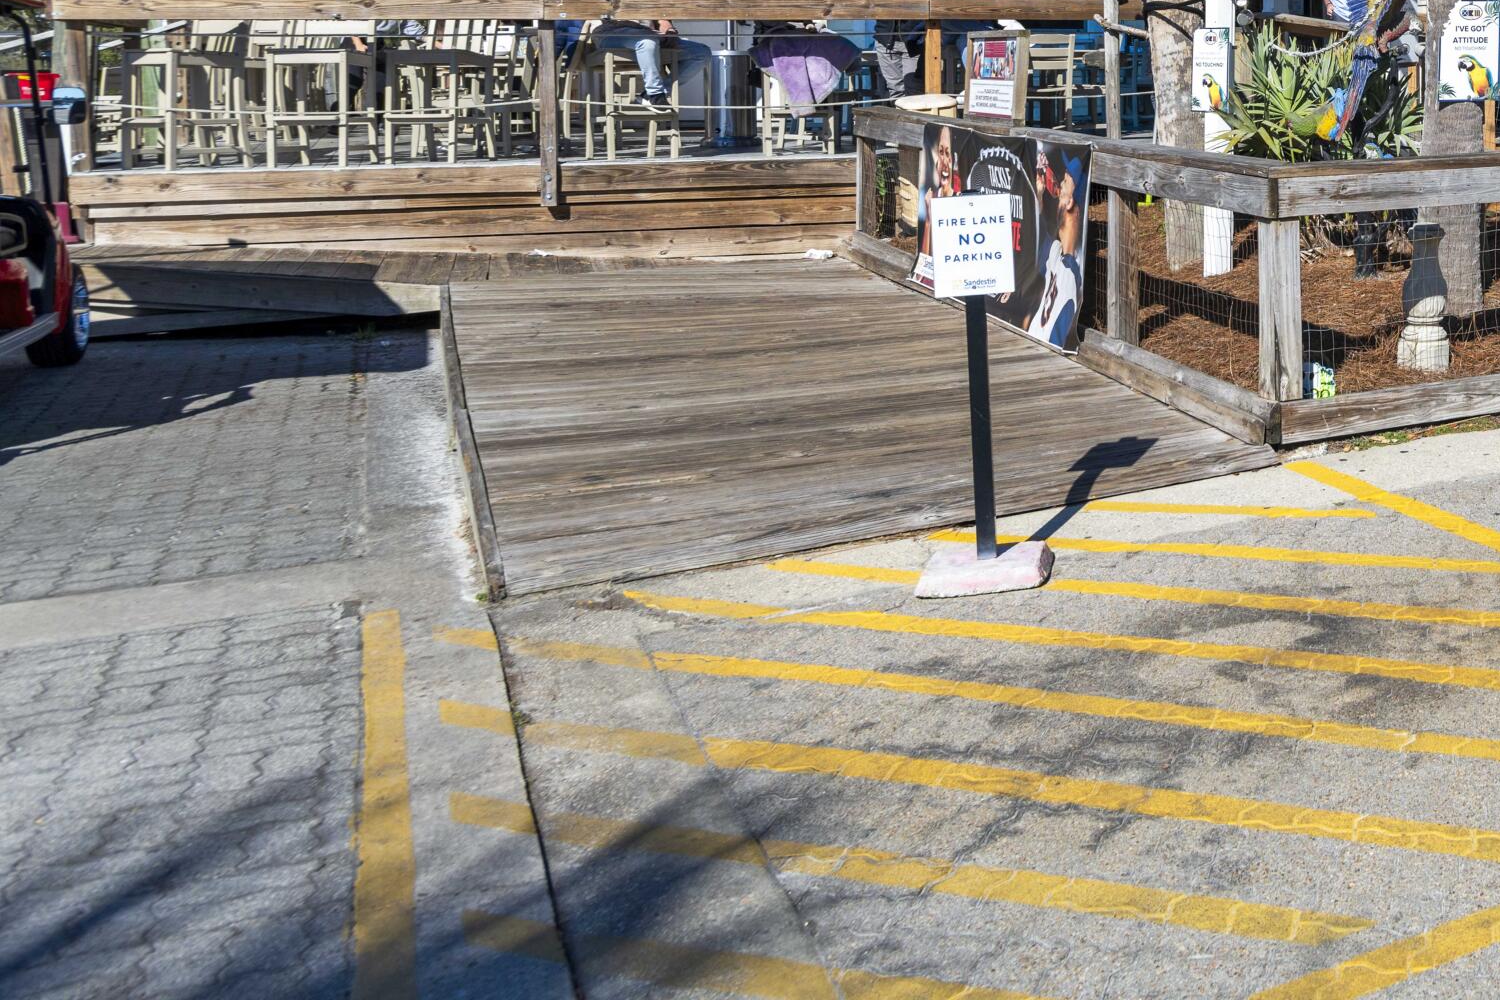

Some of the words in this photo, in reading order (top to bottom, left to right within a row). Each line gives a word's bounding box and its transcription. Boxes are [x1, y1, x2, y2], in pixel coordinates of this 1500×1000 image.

[988, 164, 1012, 190] TACKLE
[938, 217, 966, 227] FIRE
[973, 215, 1005, 225] LANE
[959, 232, 985, 245] NO
[945, 251, 1002, 263] PARKING
[963, 278, 996, 286] Sandestin
